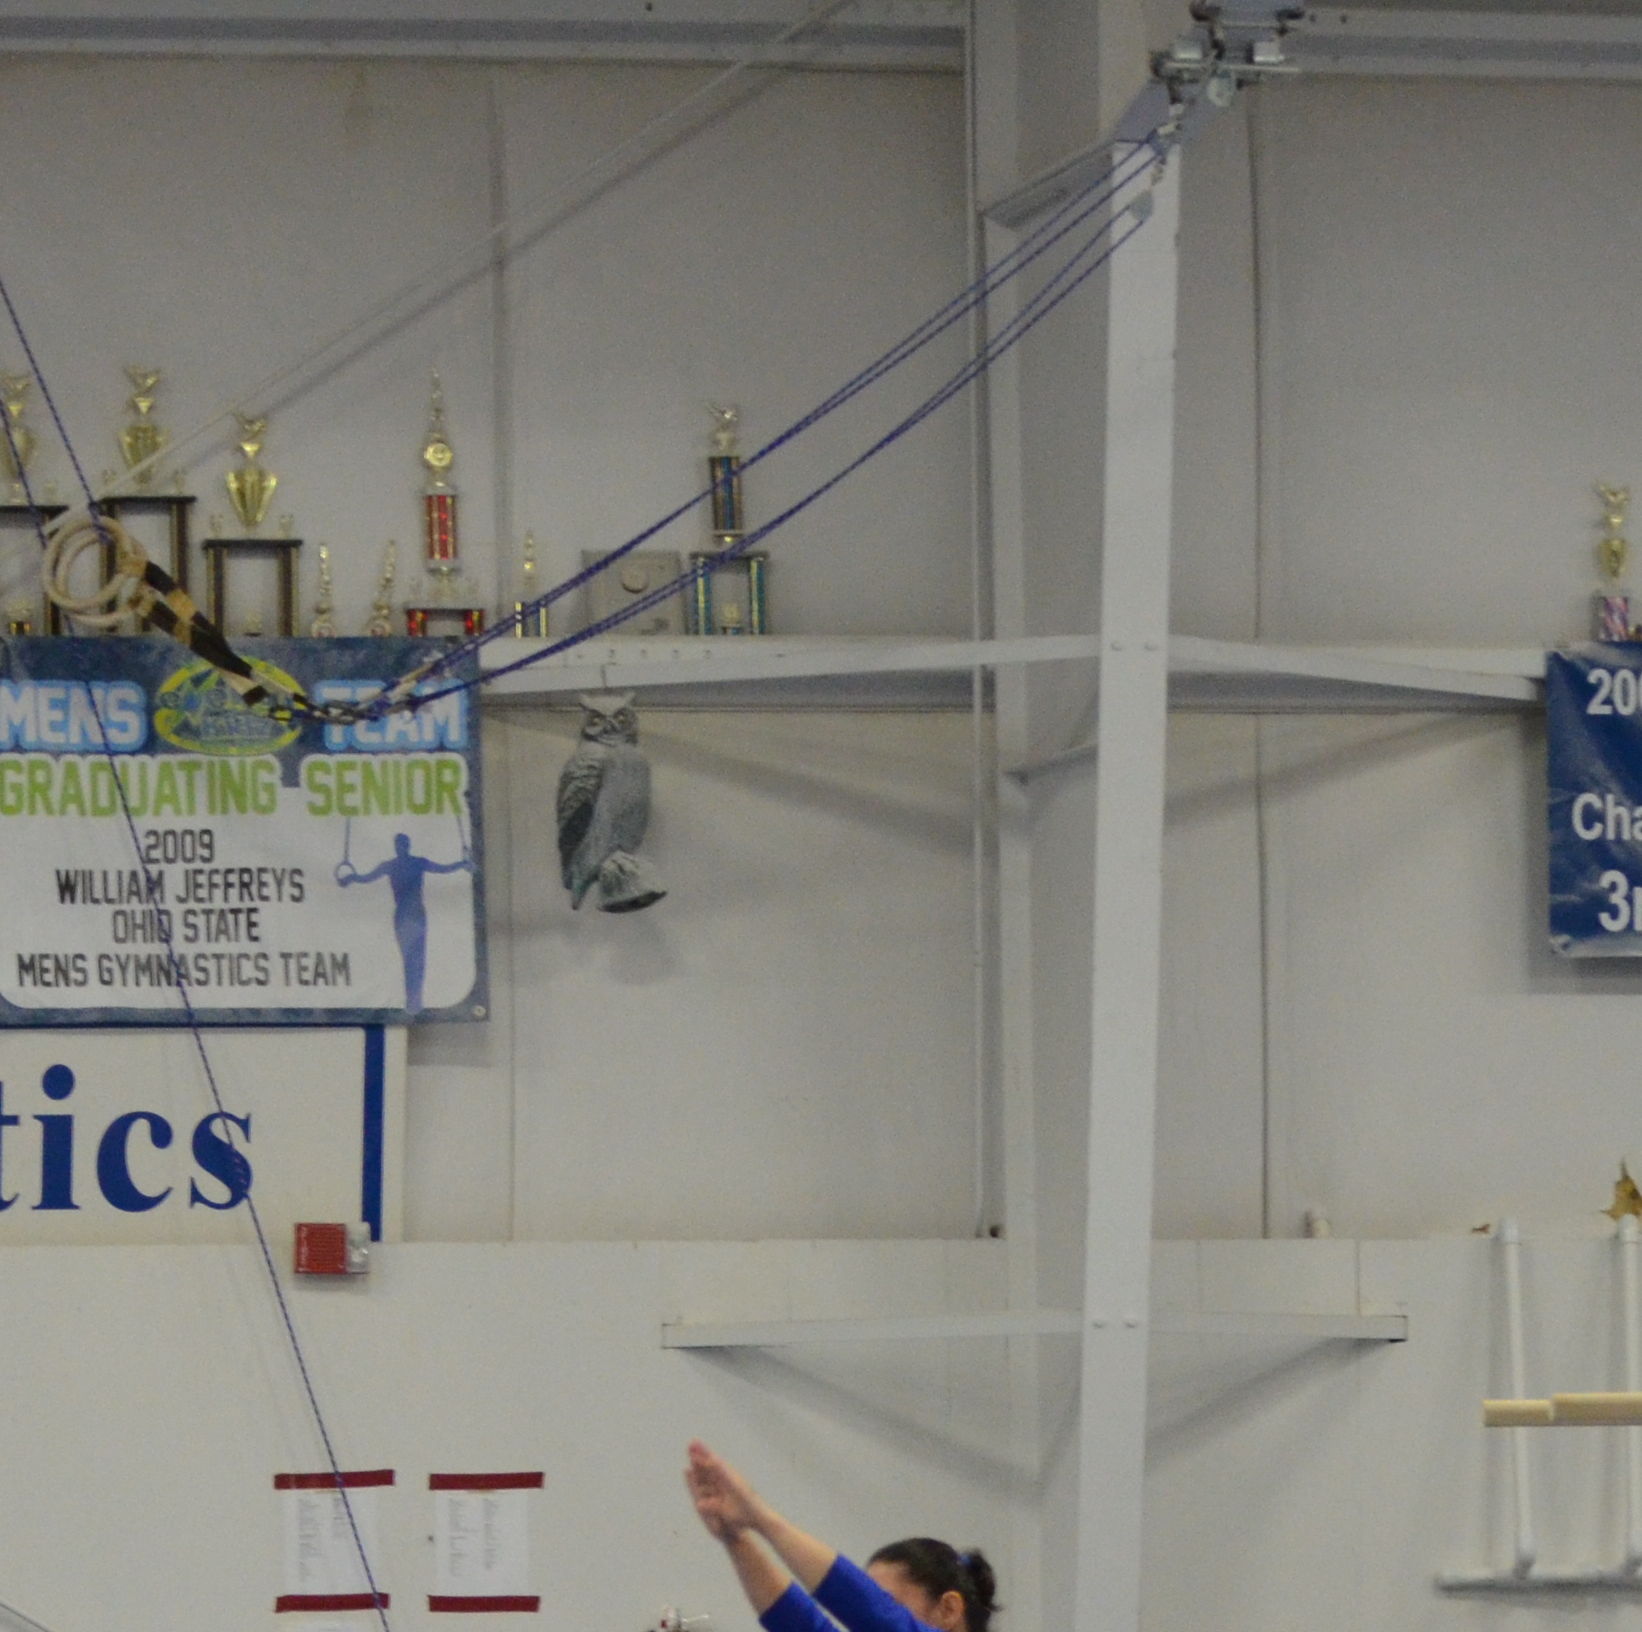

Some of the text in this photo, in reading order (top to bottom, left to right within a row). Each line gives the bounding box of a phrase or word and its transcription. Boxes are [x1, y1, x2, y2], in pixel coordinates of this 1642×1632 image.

[302, 758, 465, 817] SENIOR
[143, 829, 216, 864] 2009
[56, 867, 305, 904] WILLIAM JEFFREYS
[113, 907, 261, 945] OHIO STATE
[17, 953, 352, 988] MENS GYMNASTICS TEAM
